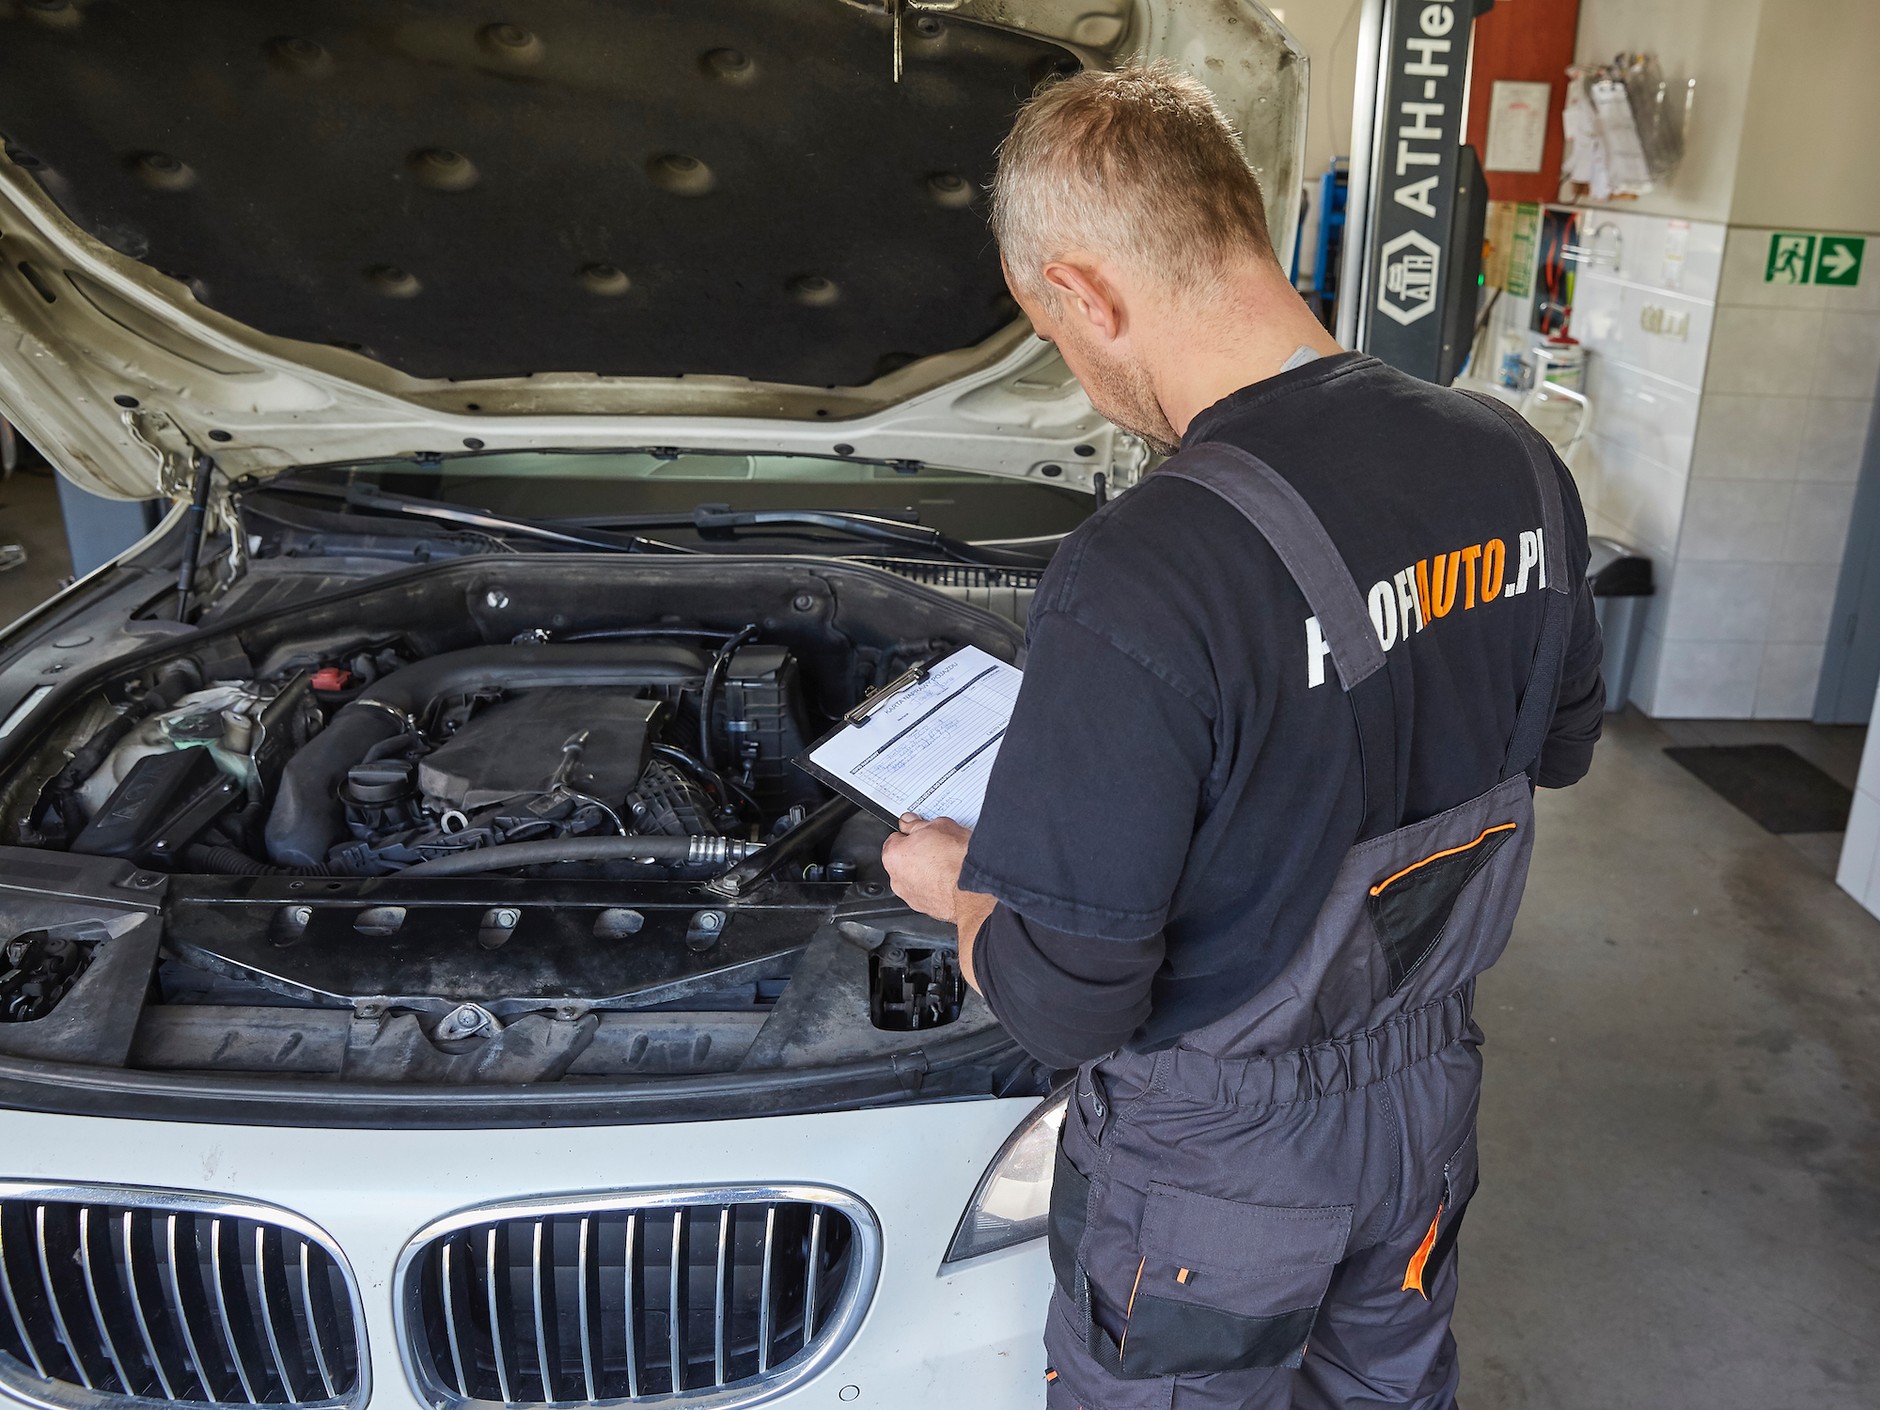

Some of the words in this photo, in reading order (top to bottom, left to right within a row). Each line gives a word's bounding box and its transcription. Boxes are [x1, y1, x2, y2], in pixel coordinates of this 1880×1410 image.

[1394, 0, 1456, 218] ATH-He
[1400, 254, 1432, 301] ATH
[1305, 528, 1547, 689] POFIAUTO.PL
[884, 700, 905, 715] KARTA
